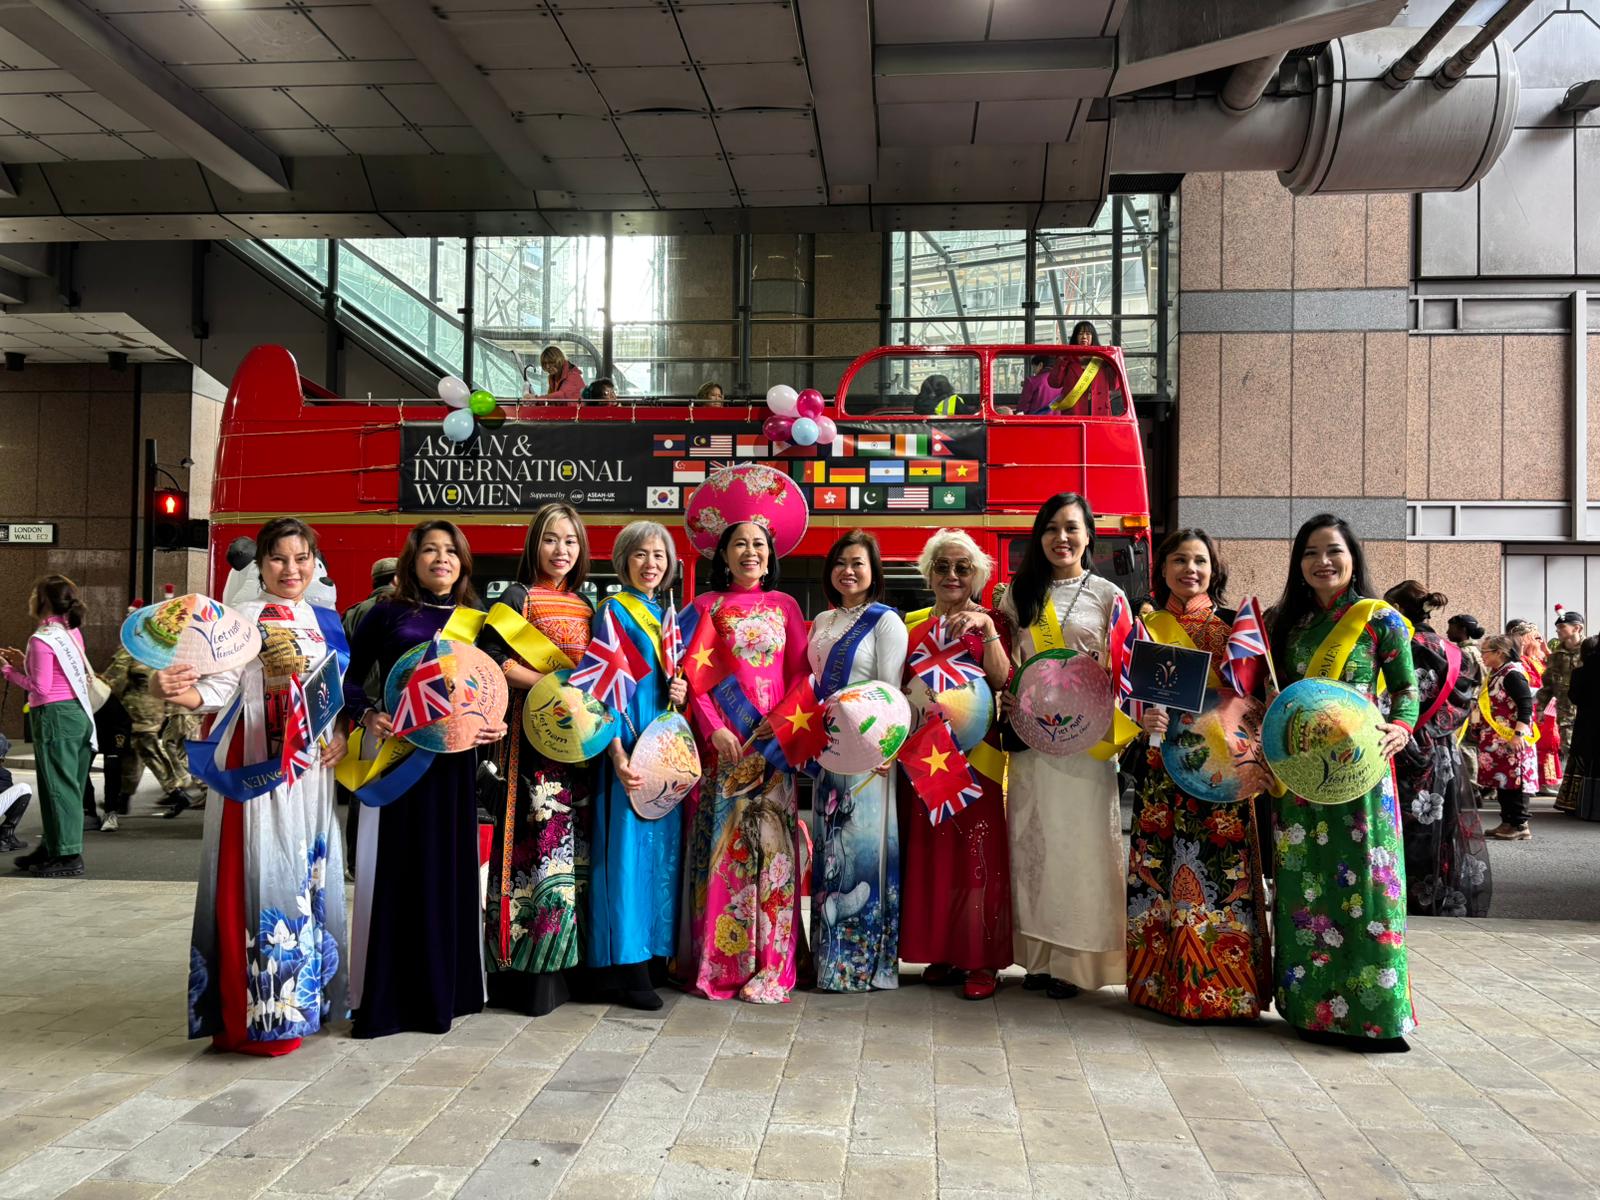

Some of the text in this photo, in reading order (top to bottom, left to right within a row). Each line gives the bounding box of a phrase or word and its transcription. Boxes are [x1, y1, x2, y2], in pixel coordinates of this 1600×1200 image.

[415, 435, 533, 457] ASEAN &
[413, 459, 632, 482] INTERNATIONAL
[415, 484, 523, 506] WOMEN
[529, 491, 566, 500] Supported by
[36, 533, 49, 541] EC2
[838, 622, 868, 656] WOMEN
[1319, 644, 1342, 678] OMEN
[241, 768, 283, 789] OMEN
